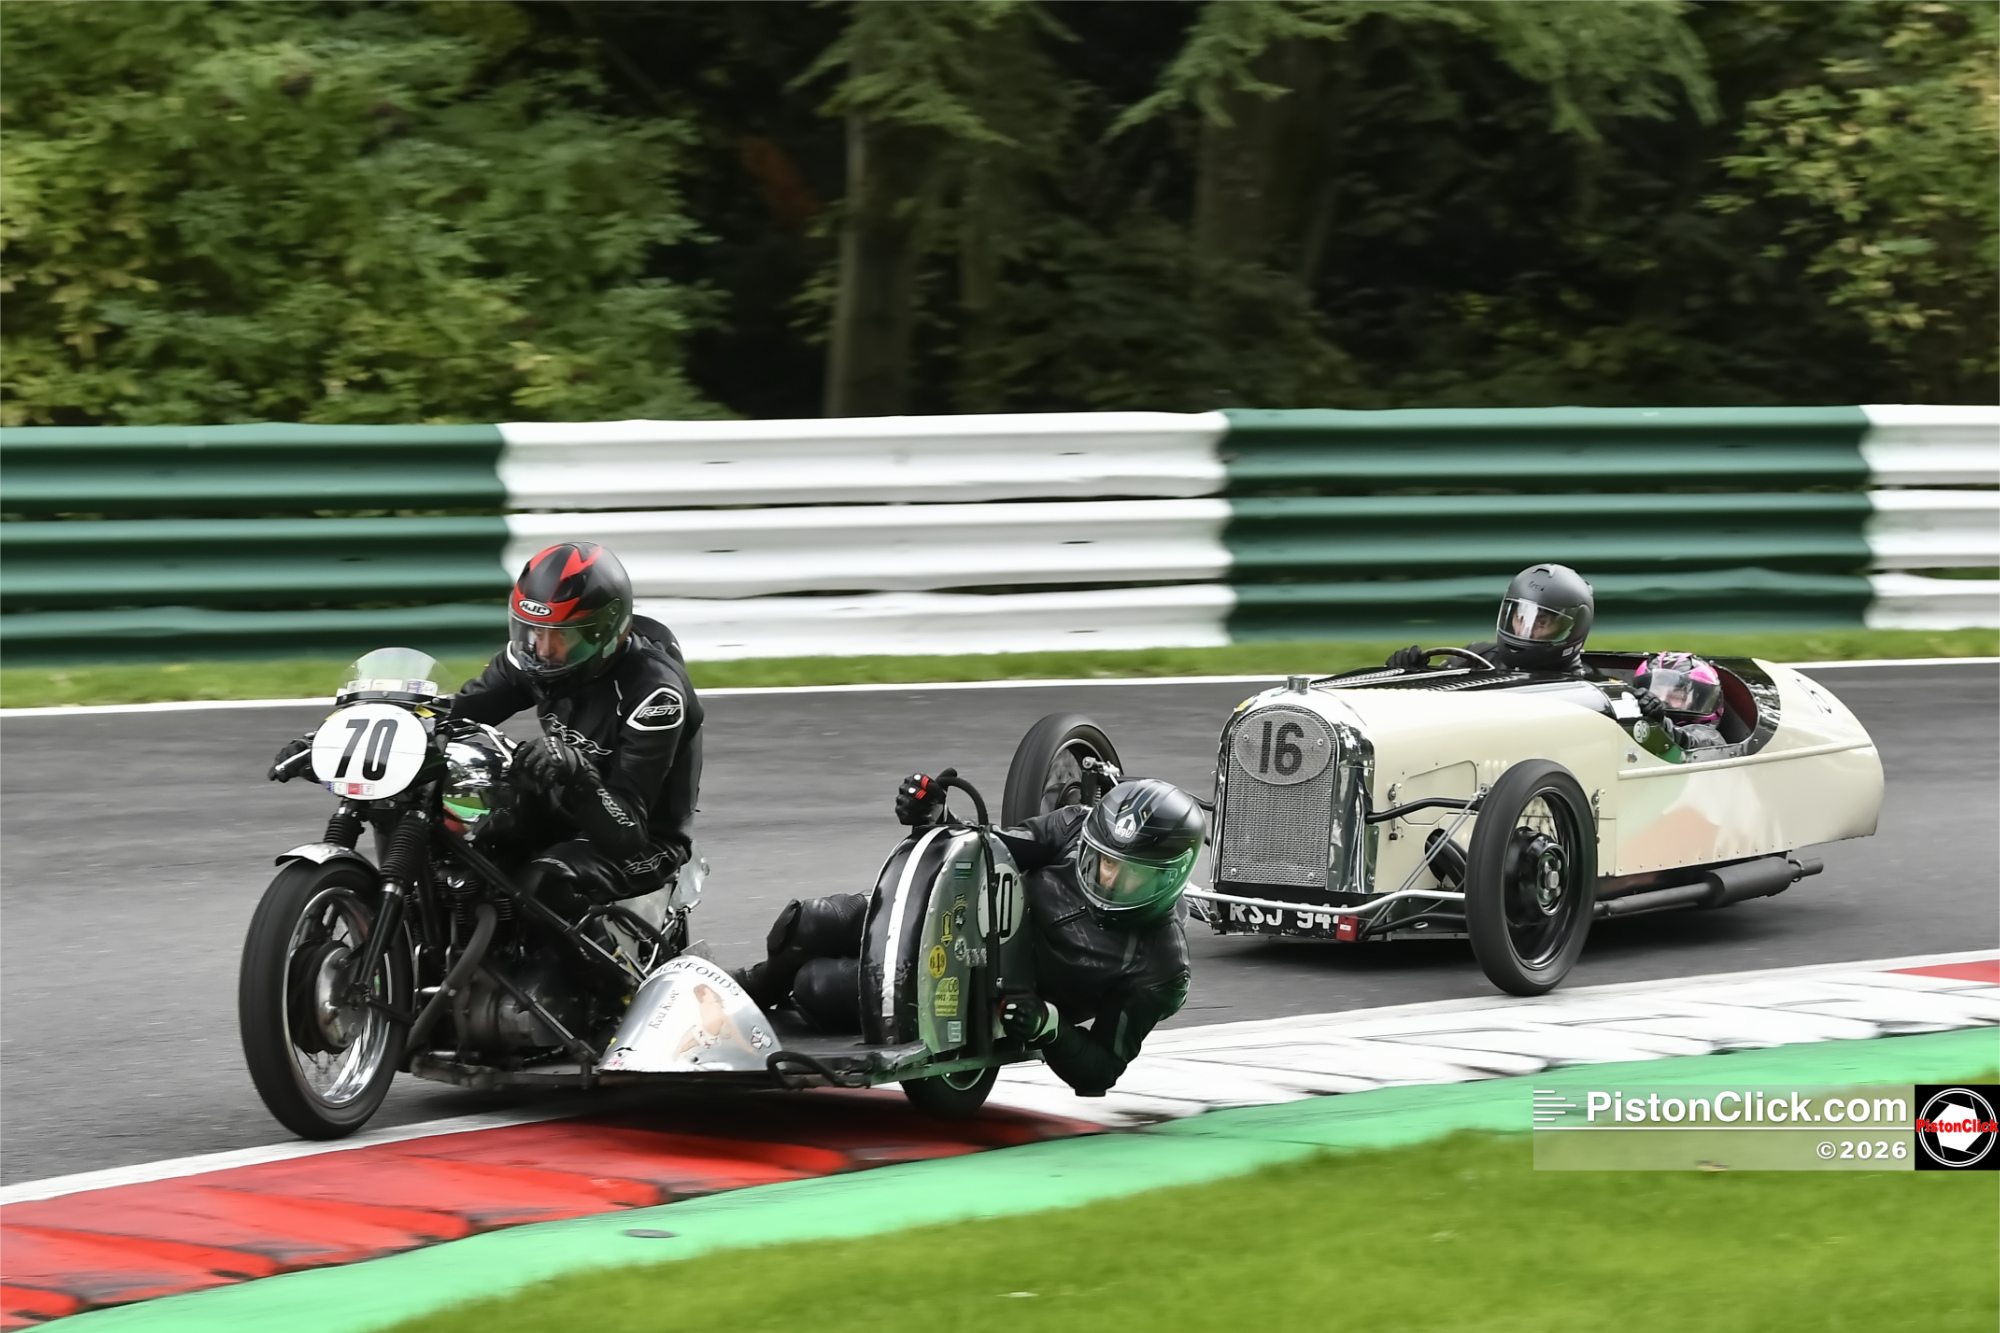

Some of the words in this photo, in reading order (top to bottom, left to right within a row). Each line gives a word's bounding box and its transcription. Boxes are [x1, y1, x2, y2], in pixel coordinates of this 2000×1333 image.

[521, 601, 547, 615] HJC
[636, 704, 682, 719] RST
[334, 718, 399, 781] 70
[1258, 720, 1305, 776] 16
